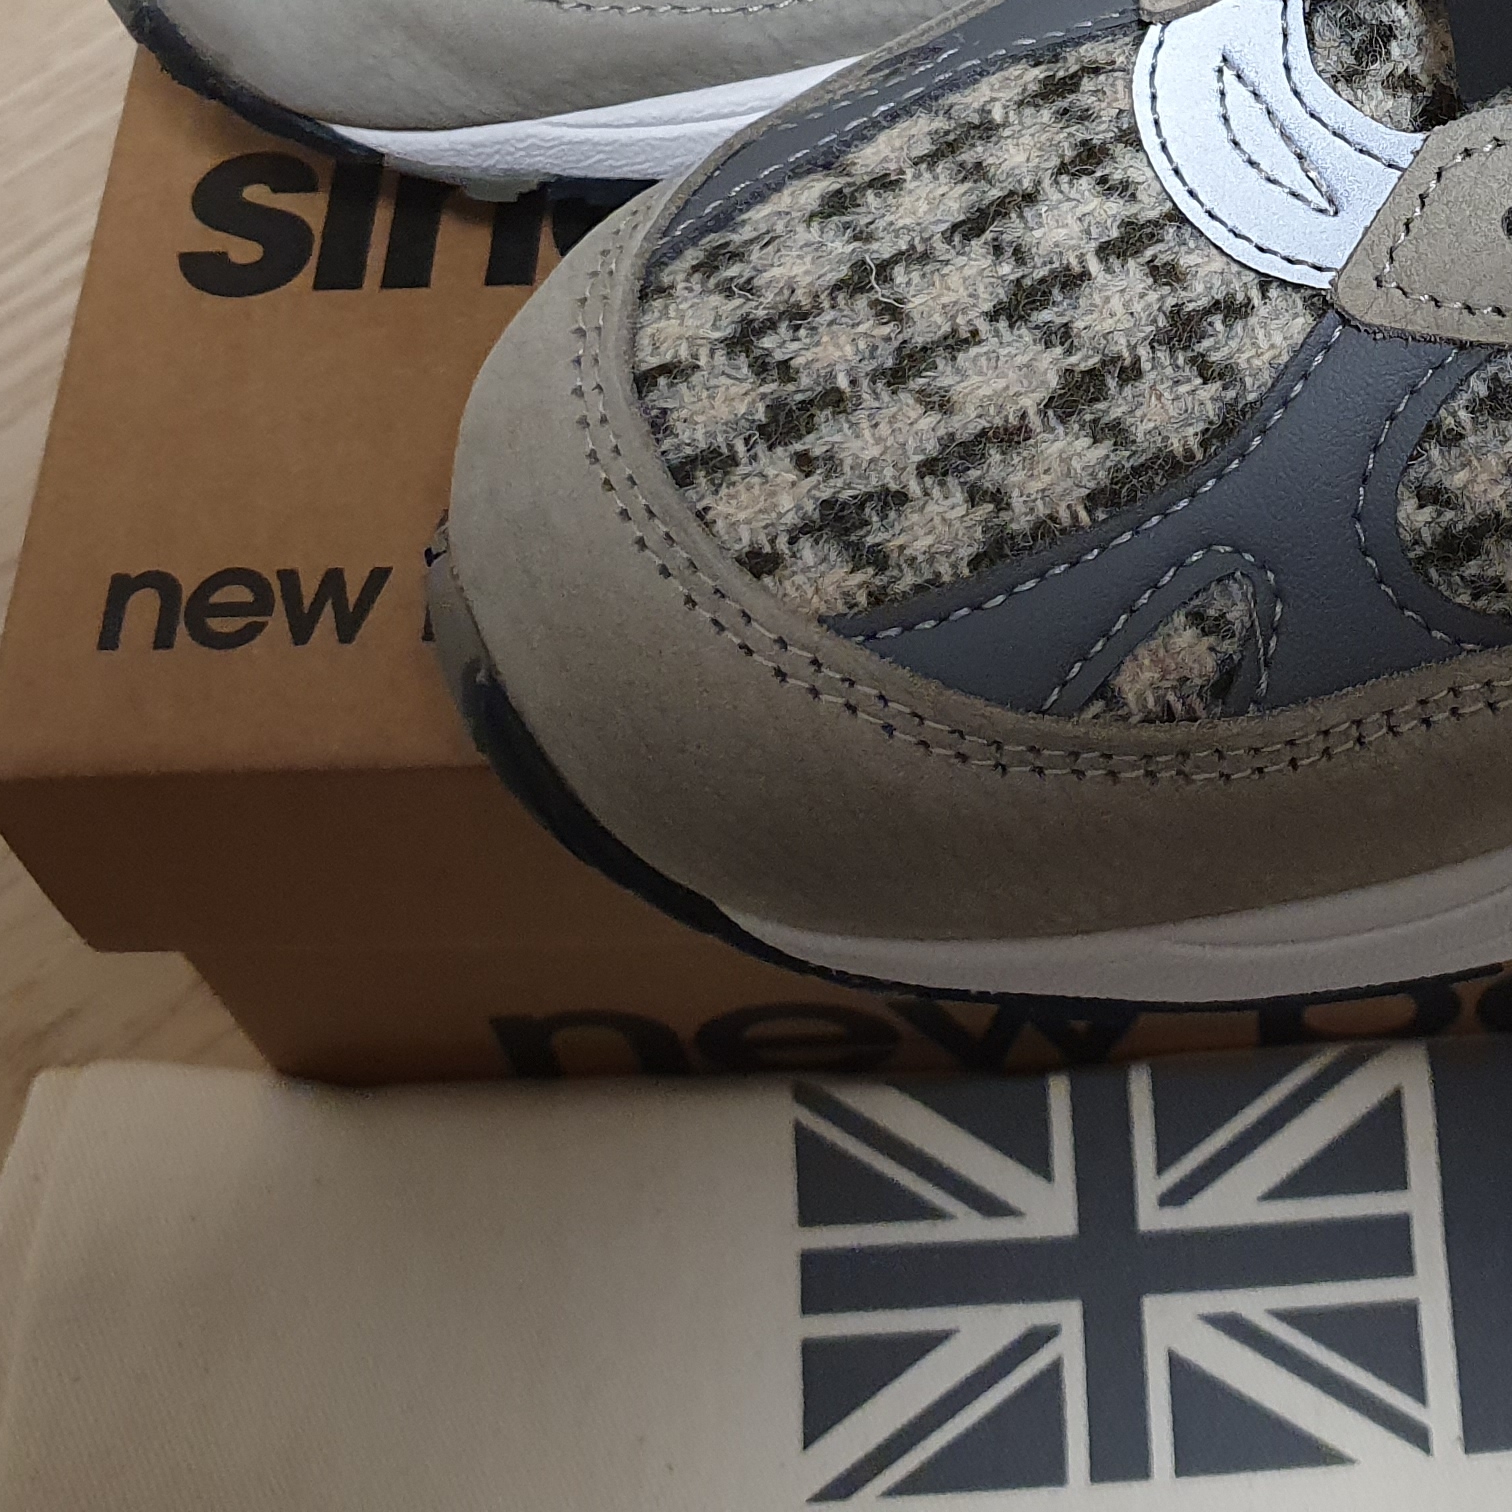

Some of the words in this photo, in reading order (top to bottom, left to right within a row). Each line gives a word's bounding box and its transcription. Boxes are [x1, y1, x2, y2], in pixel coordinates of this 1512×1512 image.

[178, 151, 605, 298] sin
[96, 565, 394, 651] new
[488, 992, 1142, 1077] new
